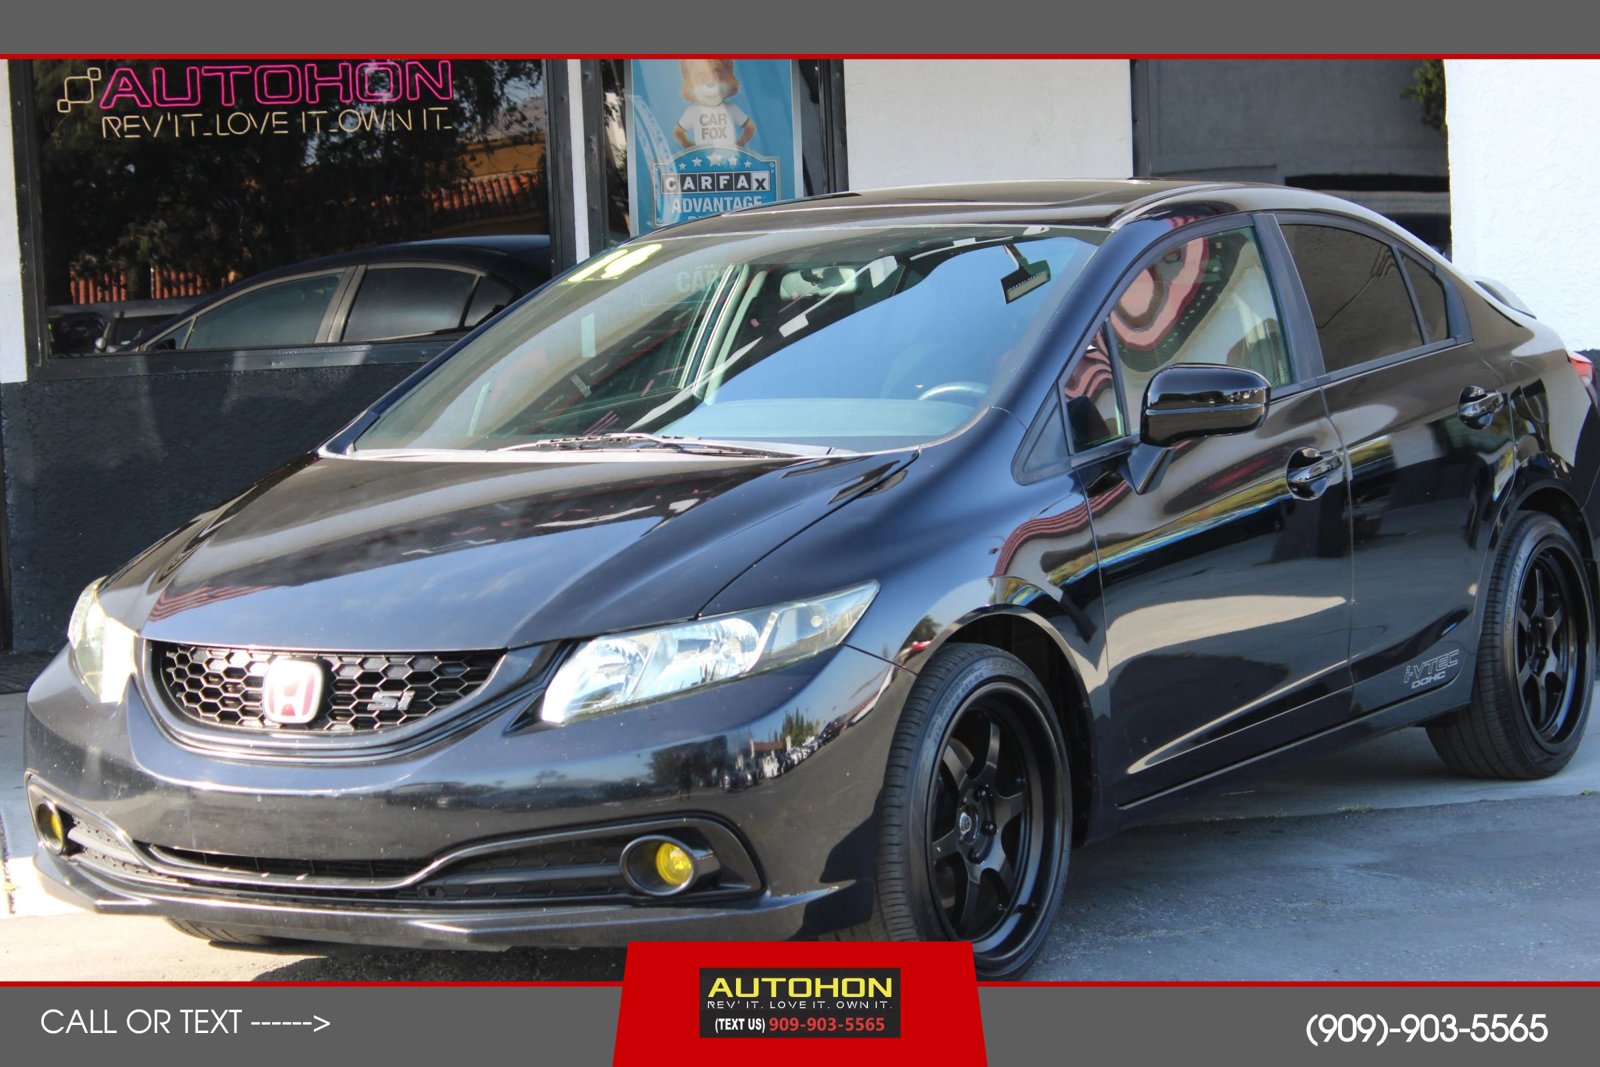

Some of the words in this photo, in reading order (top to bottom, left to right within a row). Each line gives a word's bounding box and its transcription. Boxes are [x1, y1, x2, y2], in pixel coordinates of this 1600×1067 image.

[100, 60, 453, 109] AUTOHON
[699, 112, 728, 126] CAR
[701, 127, 728, 140] FOX
[663, 173, 769, 193] CARFAX
[671, 195, 763, 213] ADVANTAGE
[1410, 671, 1446, 690] DOHC
